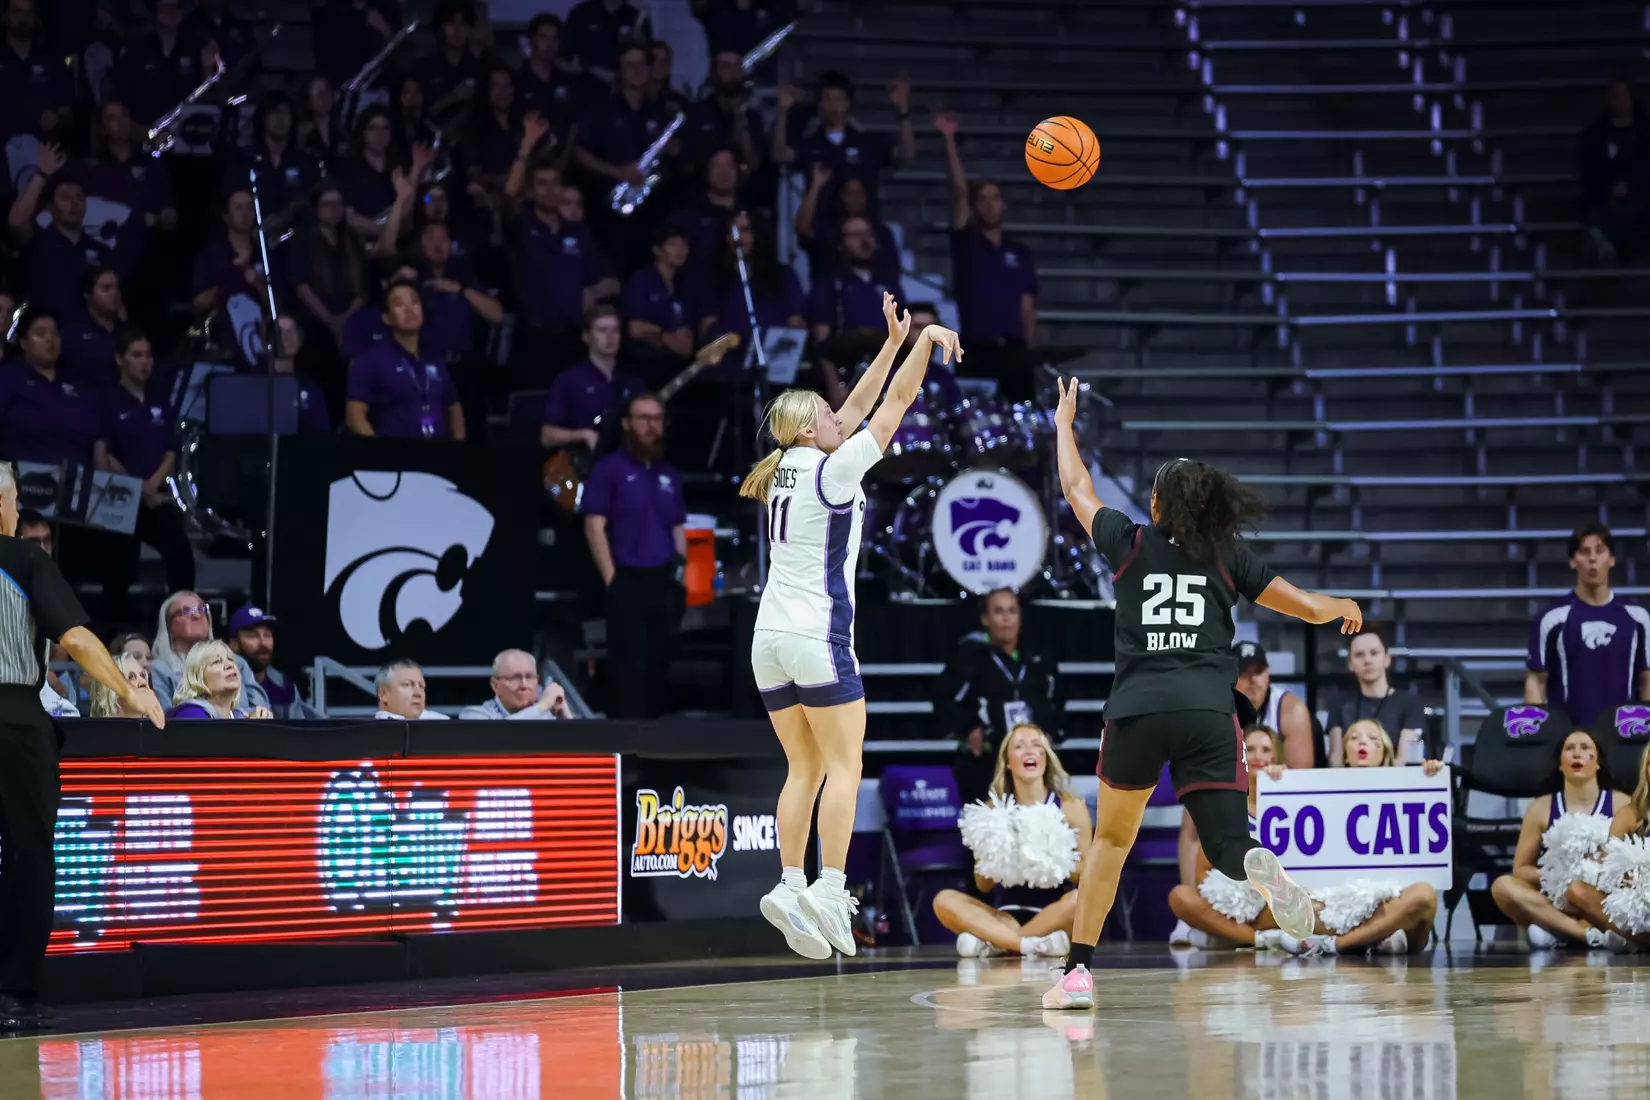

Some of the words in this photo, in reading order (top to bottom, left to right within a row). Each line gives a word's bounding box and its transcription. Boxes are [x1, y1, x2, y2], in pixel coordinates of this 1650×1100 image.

[1027, 134, 1055, 155] ELITE
[773, 467, 798, 489] SIDES
[770, 495, 792, 544] 11
[1141, 573, 1207, 627] 25
[1146, 632, 1198, 651] BLOW
[633, 789, 727, 873] Briggs
[732, 815, 774, 851] SINCE
[1260, 805, 1325, 857] GO
[1345, 802, 1449, 856] CATS
[633, 854, 679, 872] AUTO.COM
